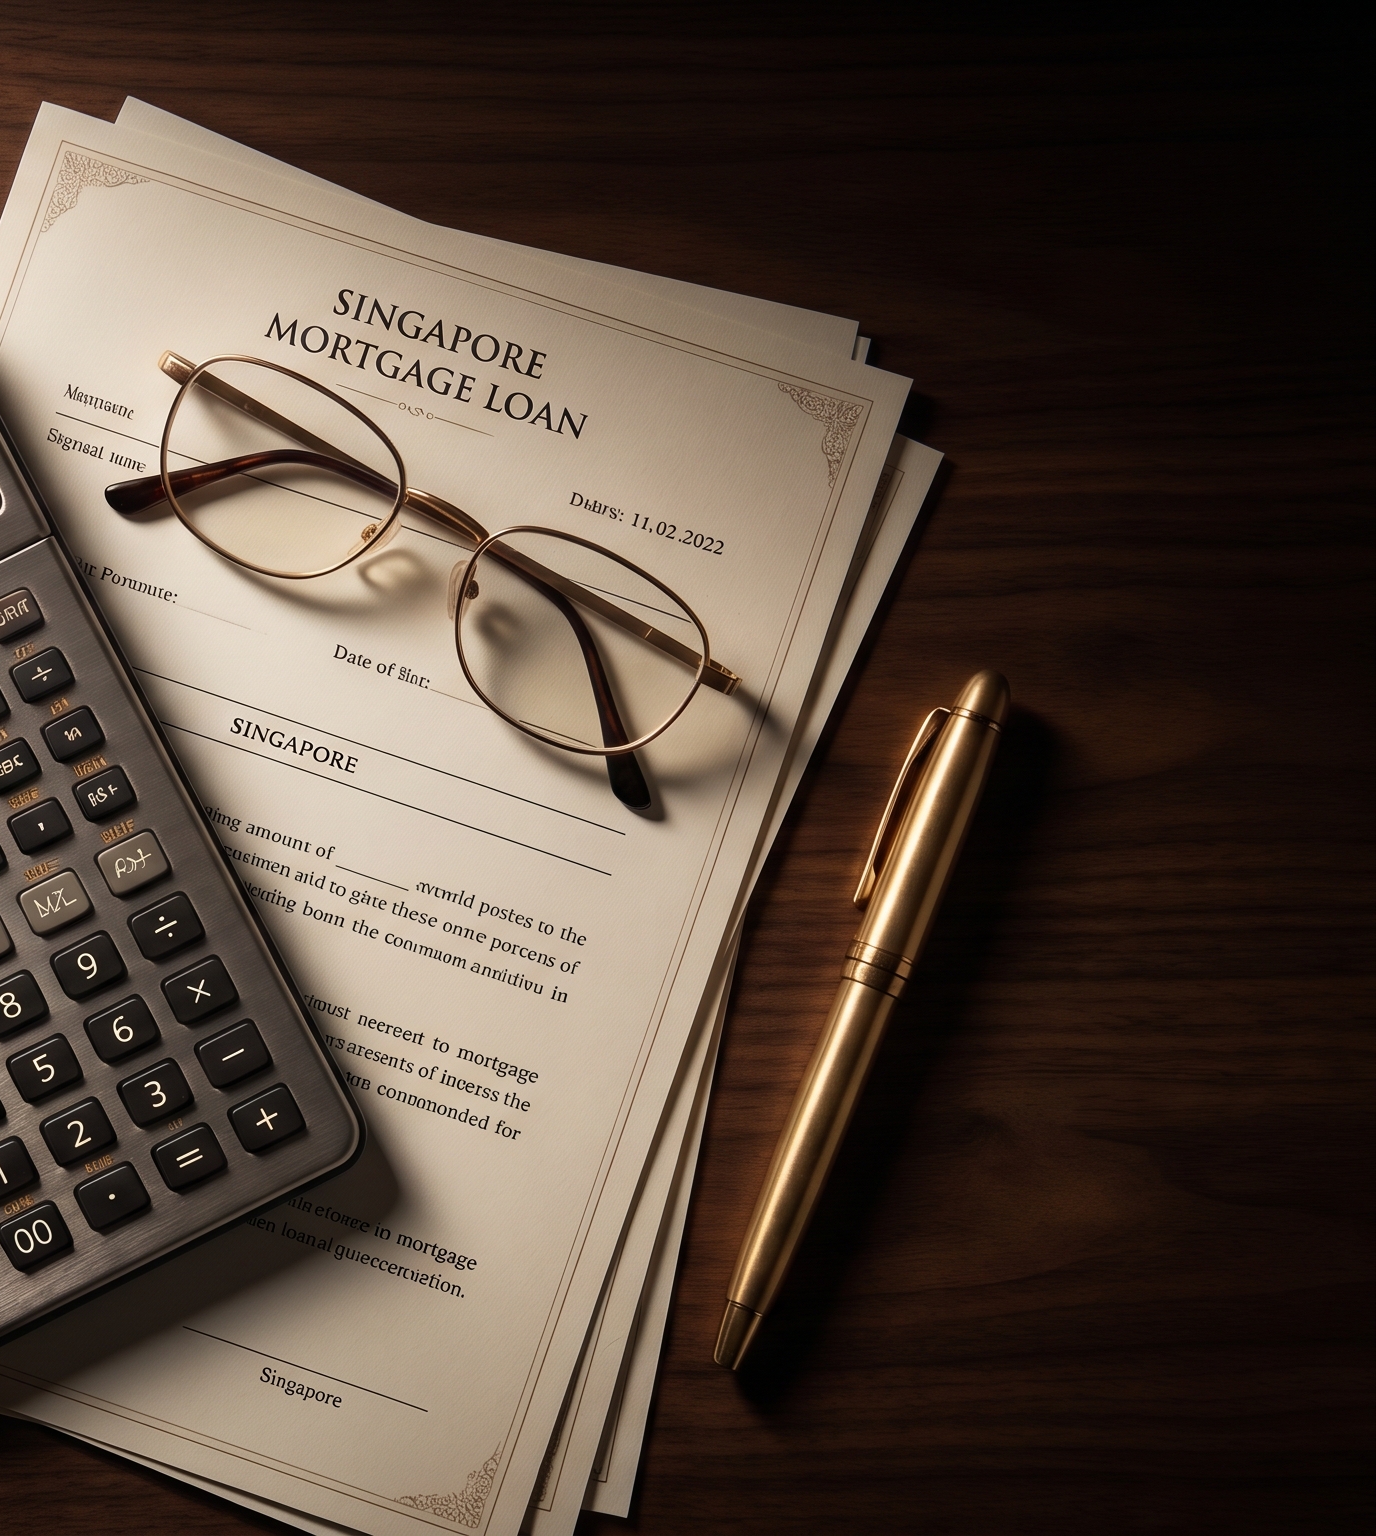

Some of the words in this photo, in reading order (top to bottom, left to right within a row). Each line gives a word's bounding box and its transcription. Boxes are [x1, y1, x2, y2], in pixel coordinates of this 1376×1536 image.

[332, 288, 547, 380] SINGAPORE
[264, 312, 476, 403] MORTGAGE
[483, 382, 588, 439] LOAN
[333, 644, 372, 669] Date
[376, 663, 396, 677] of
[230, 717, 358, 774] SINGAPORE
[246, 823, 312, 853] amount
[316, 846, 335, 860] of
[478, 901, 534, 929] postes
[538, 921, 554, 935] to
[560, 927, 587, 946] the
[329, 881, 346, 897] to
[391, 901, 438, 927] these
[489, 937, 556, 968] porcens
[560, 961, 580, 975] of
[77, 953, 98, 980] 9
[352, 920, 379, 939] the
[551, 986, 568, 1003] in
[0, 992, 22, 1018] 8
[112, 1015, 134, 1043] 6
[32, 1054, 55, 1083] 5
[346, 1041, 414, 1073] aresents
[418, 1066, 438, 1080] of
[440, 1070, 500, 1102] incerss
[504, 1092, 531, 1112] the
[432, 1037, 450, 1053] to
[457, 1047, 538, 1085] mortgage
[144, 1080, 167, 1108] 3
[67, 1120, 92, 1148] 2
[495, 1120, 521, 1140] for
[14, 1219, 52, 1254] 00
[396, 1233, 477, 1270] mortgage
[260, 1367, 342, 1409] Singapore
